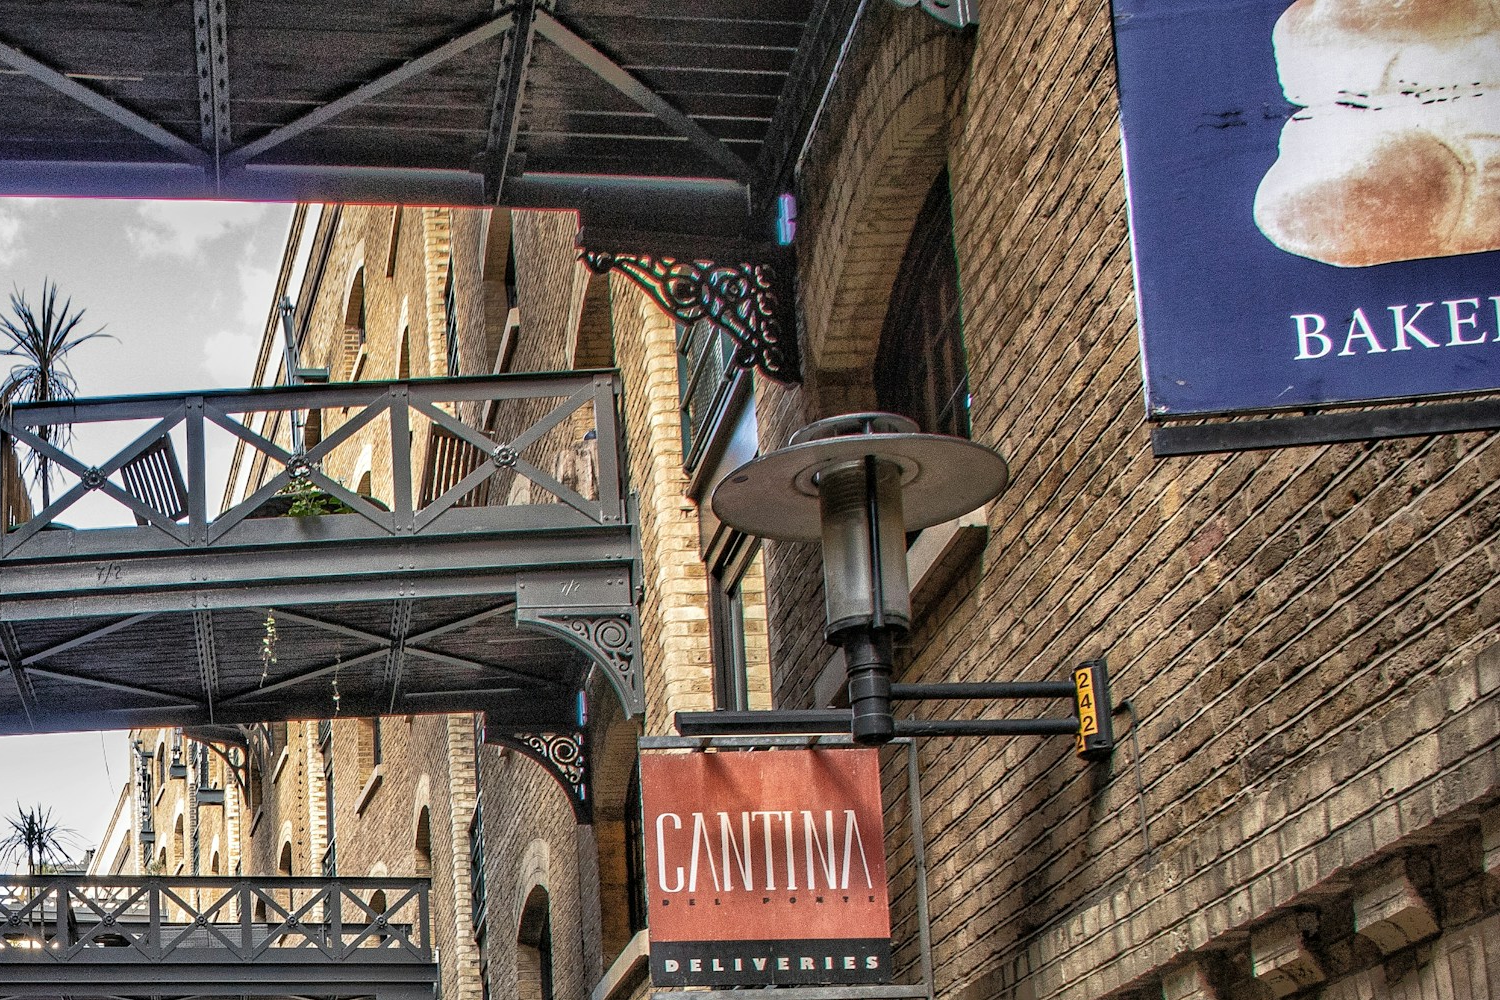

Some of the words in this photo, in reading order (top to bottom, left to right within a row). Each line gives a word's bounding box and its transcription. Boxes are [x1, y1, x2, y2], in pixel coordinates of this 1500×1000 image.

[656, 810, 873, 893] CANTINA
[662, 898, 721, 906] DEL
[762, 895, 875, 904] PONTE
[665, 956, 879, 973] DELIVERIES
